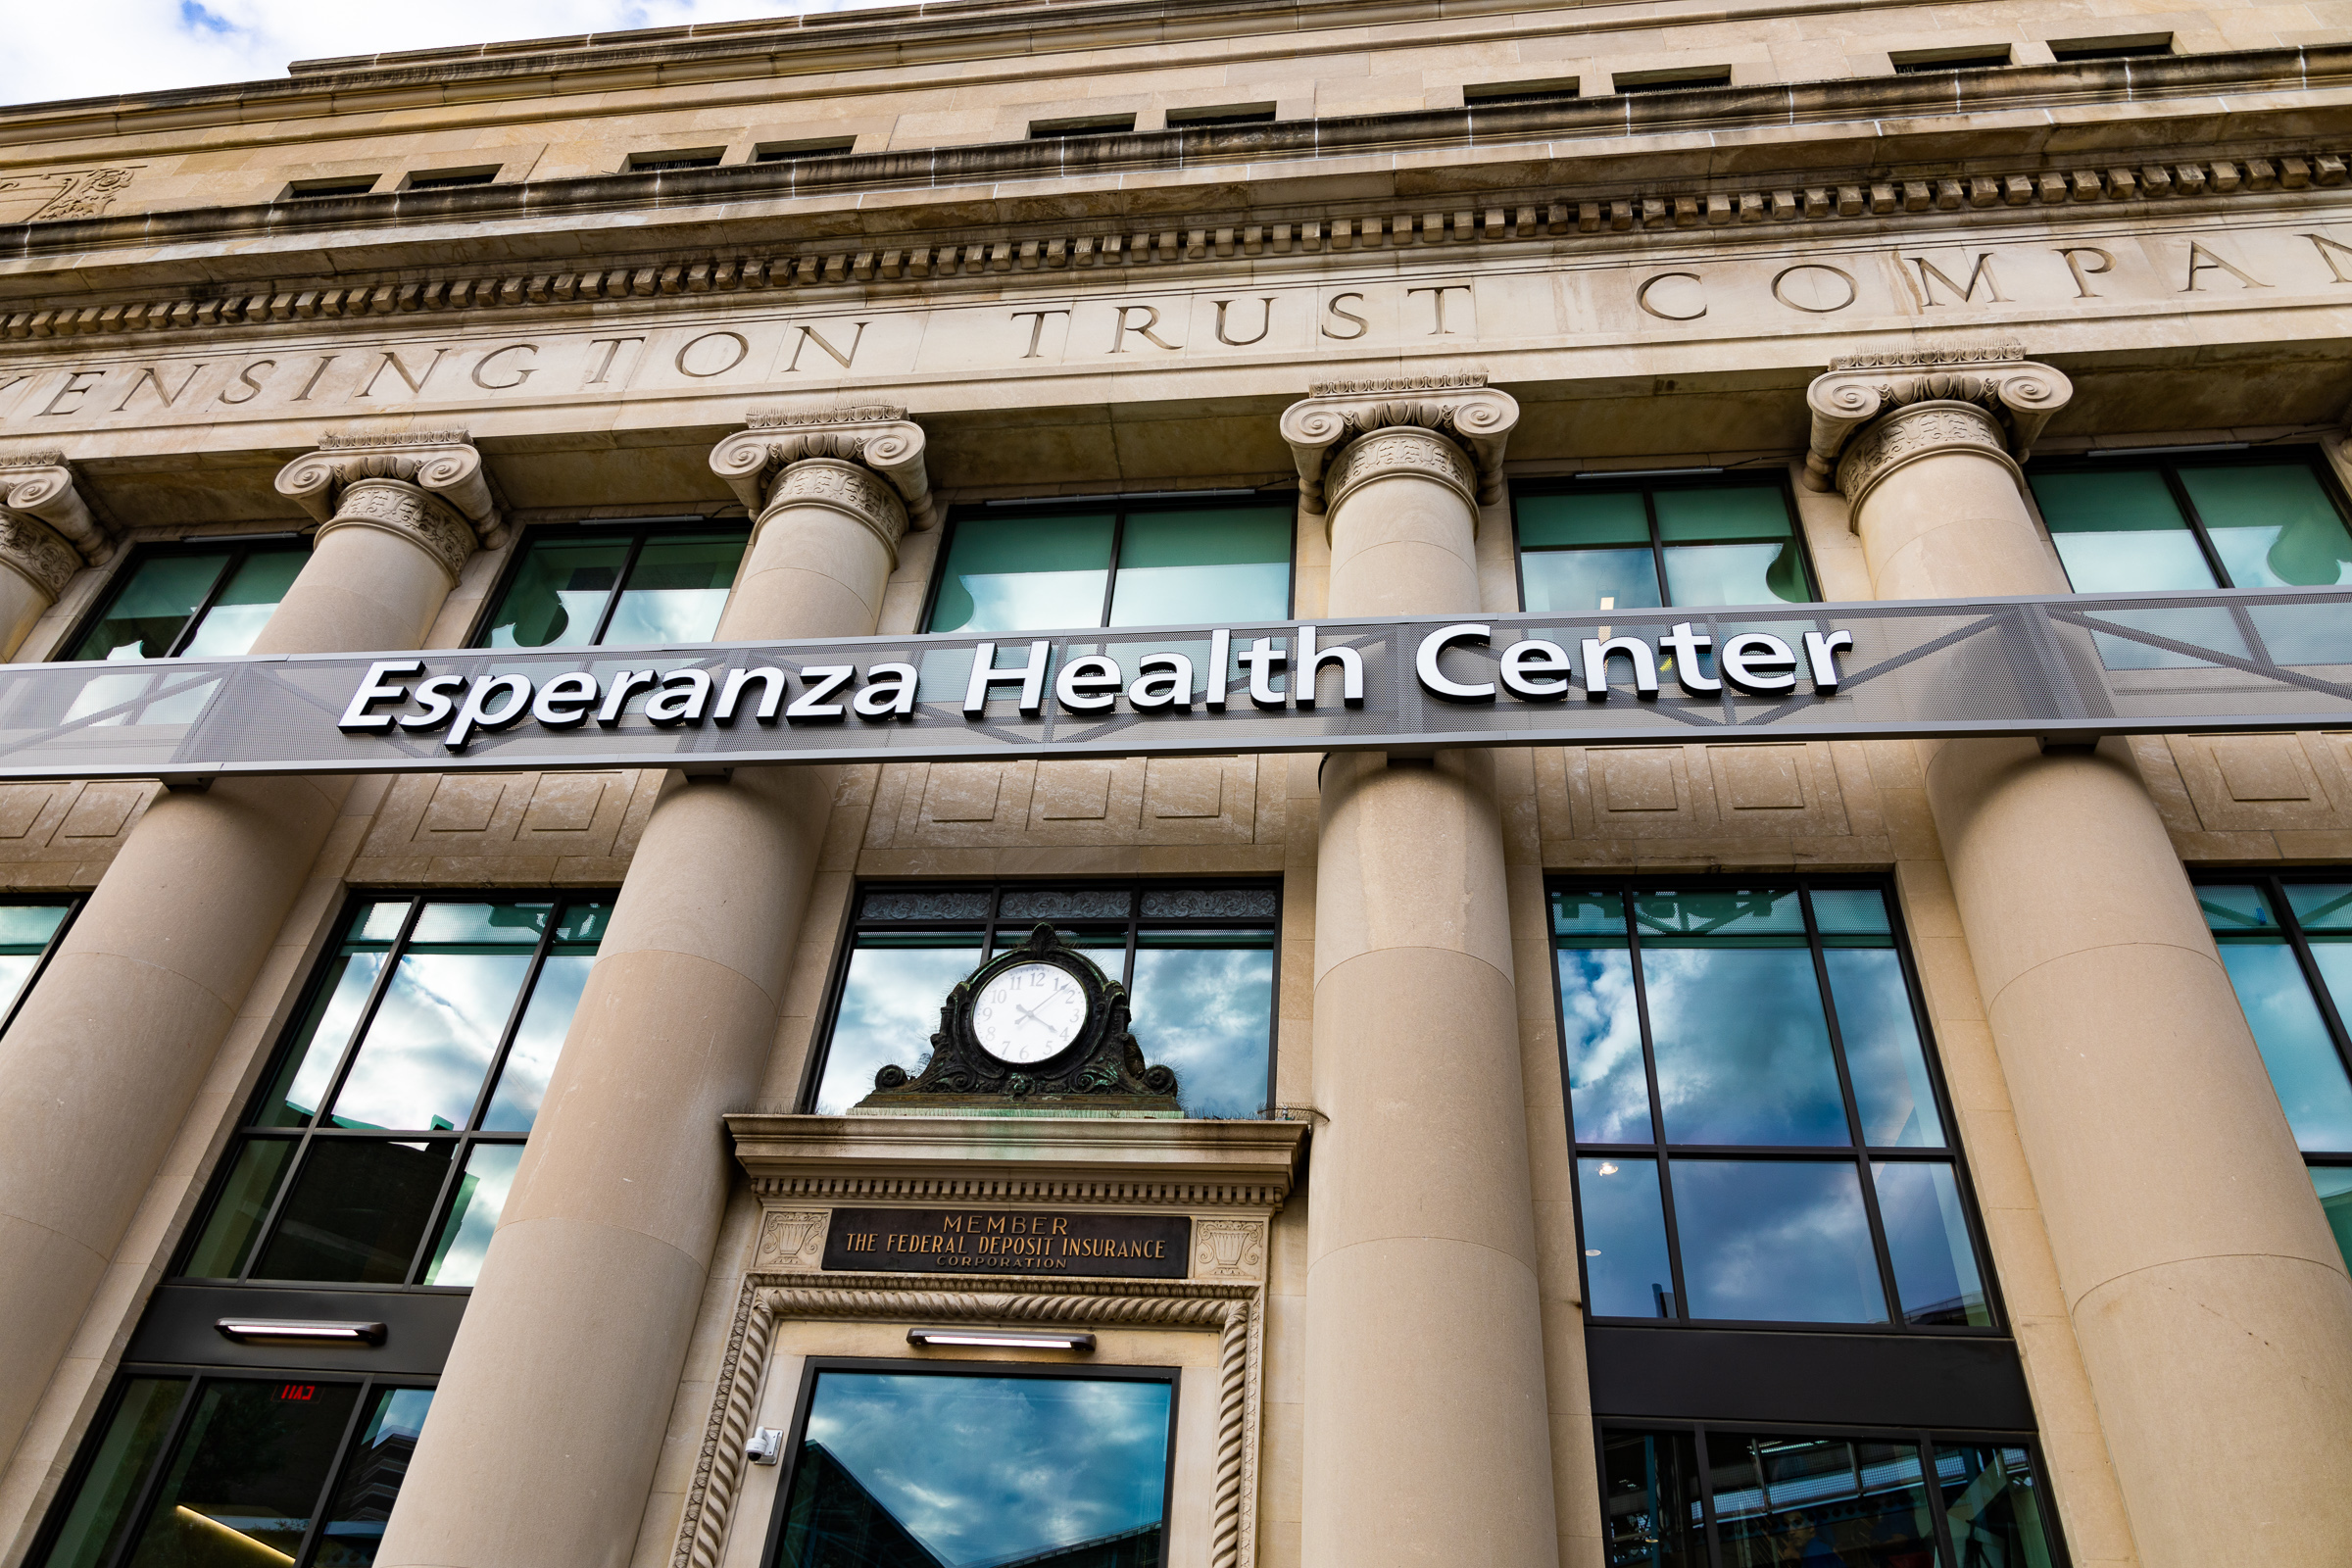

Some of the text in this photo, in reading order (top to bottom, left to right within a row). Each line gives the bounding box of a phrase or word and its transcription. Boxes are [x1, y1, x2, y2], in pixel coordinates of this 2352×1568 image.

[1010, 284, 1472, 360] TRUST
[339, 621, 1854, 753] Esperanza Health Center
[1009, 976, 1022, 991] 11
[1029, 972, 1046, 987] 12
[1054, 977, 1059, 991] 1
[991, 989, 1006, 1004] 10
[1065, 989, 1075, 1004] 2
[982, 1007, 993, 1021] 9
[1069, 1008, 1080, 1023] 3
[985, 1026, 996, 1042] 8
[1059, 1026, 1070, 1041] 4
[1002, 1041, 1010, 1055] 7
[1019, 1045, 1029, 1060] 6
[1043, 1041, 1053, 1054] 5
[943, 1215, 1068, 1236] MEMBER
[847, 1233, 1166, 1258] THE FEDERAL DEPOSIT INSURANCE
[936, 1255, 1067, 1269] CORPORATION
